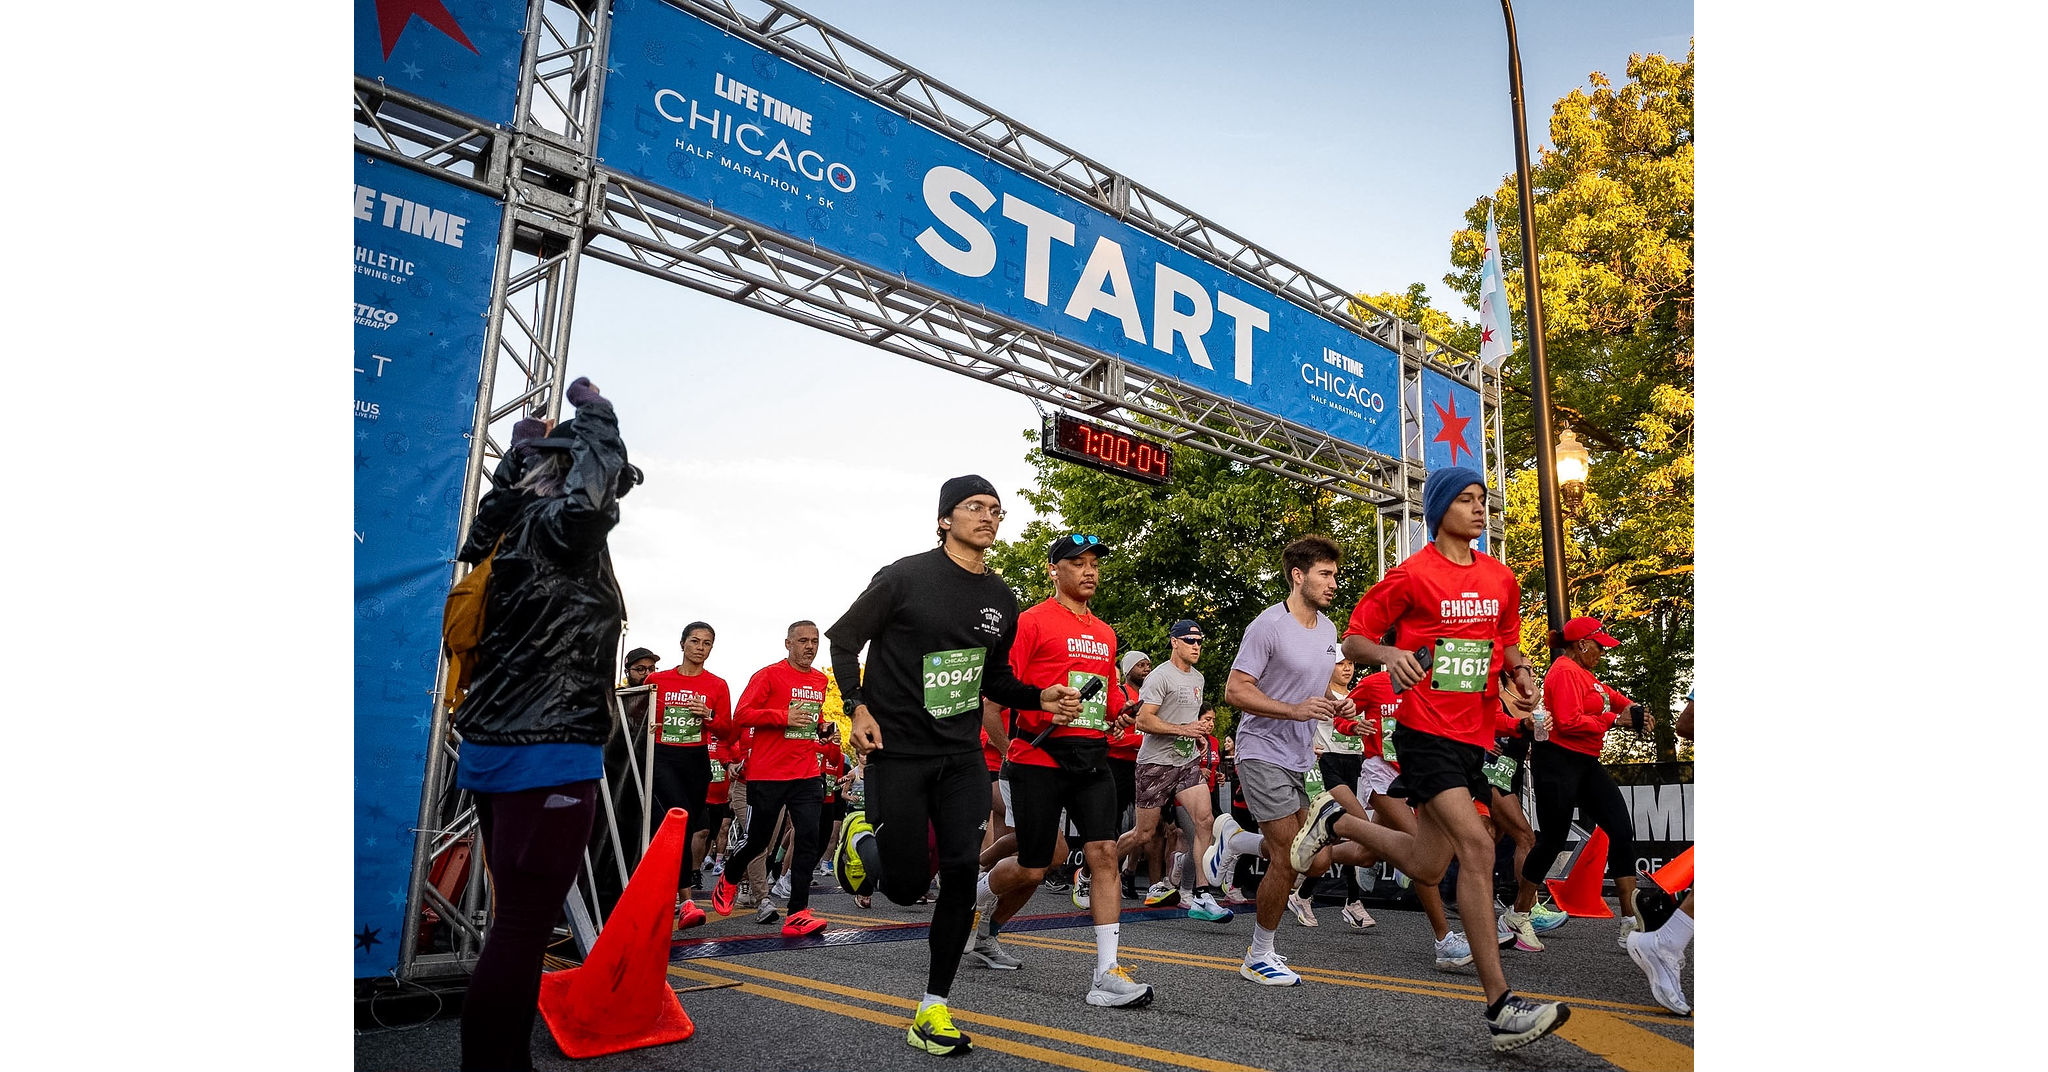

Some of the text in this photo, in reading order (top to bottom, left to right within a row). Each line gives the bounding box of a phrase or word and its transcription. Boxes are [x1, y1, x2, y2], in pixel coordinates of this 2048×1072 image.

[715, 73, 813, 135] LIFE TIME
[654, 89, 856, 193] CHICAGO
[676, 138, 714, 160] HALF
[721, 156, 799, 195] MARATHON
[818, 197, 834, 209] 5K
[381, 192, 466, 249] TIME
[354, 245, 415, 276] HLETIC
[915, 165, 1270, 385] START
[1323, 347, 1364, 378] LIFE TIME
[1301, 363, 1384, 412] CHICAGO
[354, 399, 380, 415] IUS
[1311, 394, 1327, 405] HALF
[1329, 401, 1362, 419] MARATHON
[1440, 599, 1499, 618] CHICAGO
[1067, 637, 1109, 657] CHICAGO
[945, 656, 969, 664] CHICAGO
[1435, 656, 1489, 676] 21613
[924, 666, 983, 688] 20947
[1460, 680, 1472, 689] 5K
[665, 691, 707, 703] CHICAO
[791, 687, 823, 700] CHICAGO
[950, 690, 961, 699] 5K
[664, 715, 703, 727] 21649
